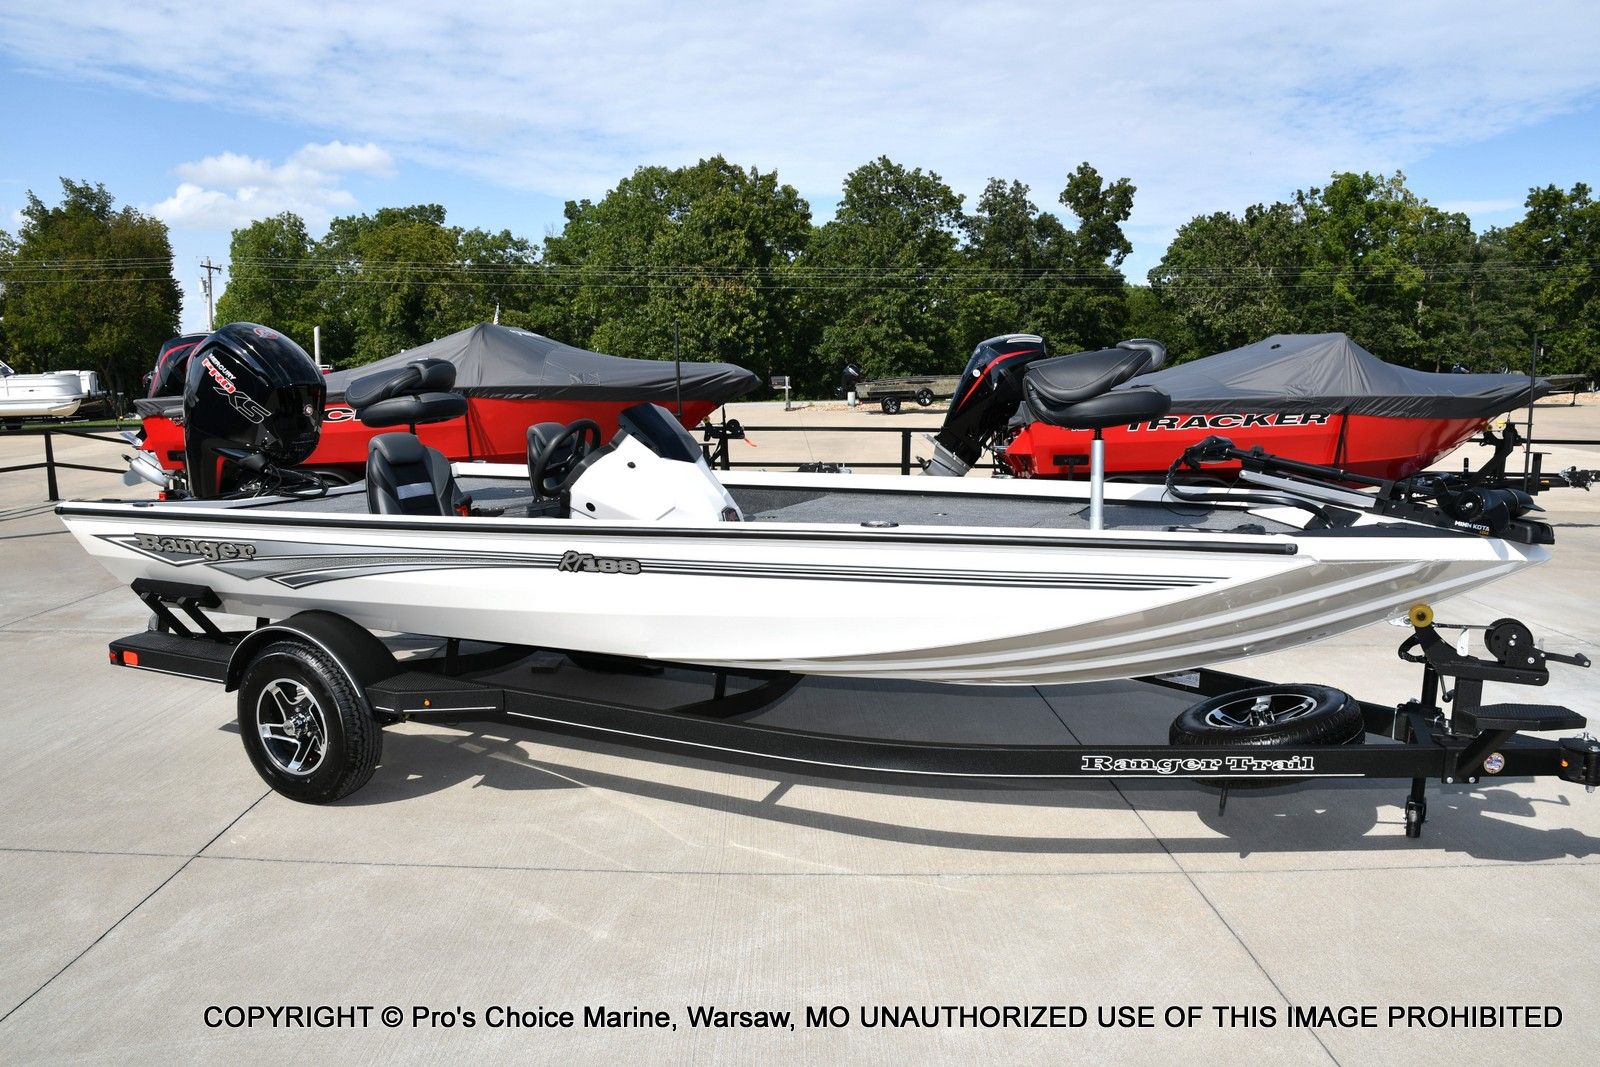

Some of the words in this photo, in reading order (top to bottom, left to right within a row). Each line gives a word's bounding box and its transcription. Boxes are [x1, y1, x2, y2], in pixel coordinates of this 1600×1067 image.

[201, 357, 236, 394] PRO
[208, 353, 236, 380] MERCURY
[212, 386, 272, 424] XS
[1454, 520, 1472, 528] MINN
[1472, 523, 1490, 531] KOTA
[134, 532, 257, 561] Ranger
[558, 550, 642, 575] RT188
[1081, 755, 1223, 774] Ranger
[1225, 756, 1315, 771] Trail
